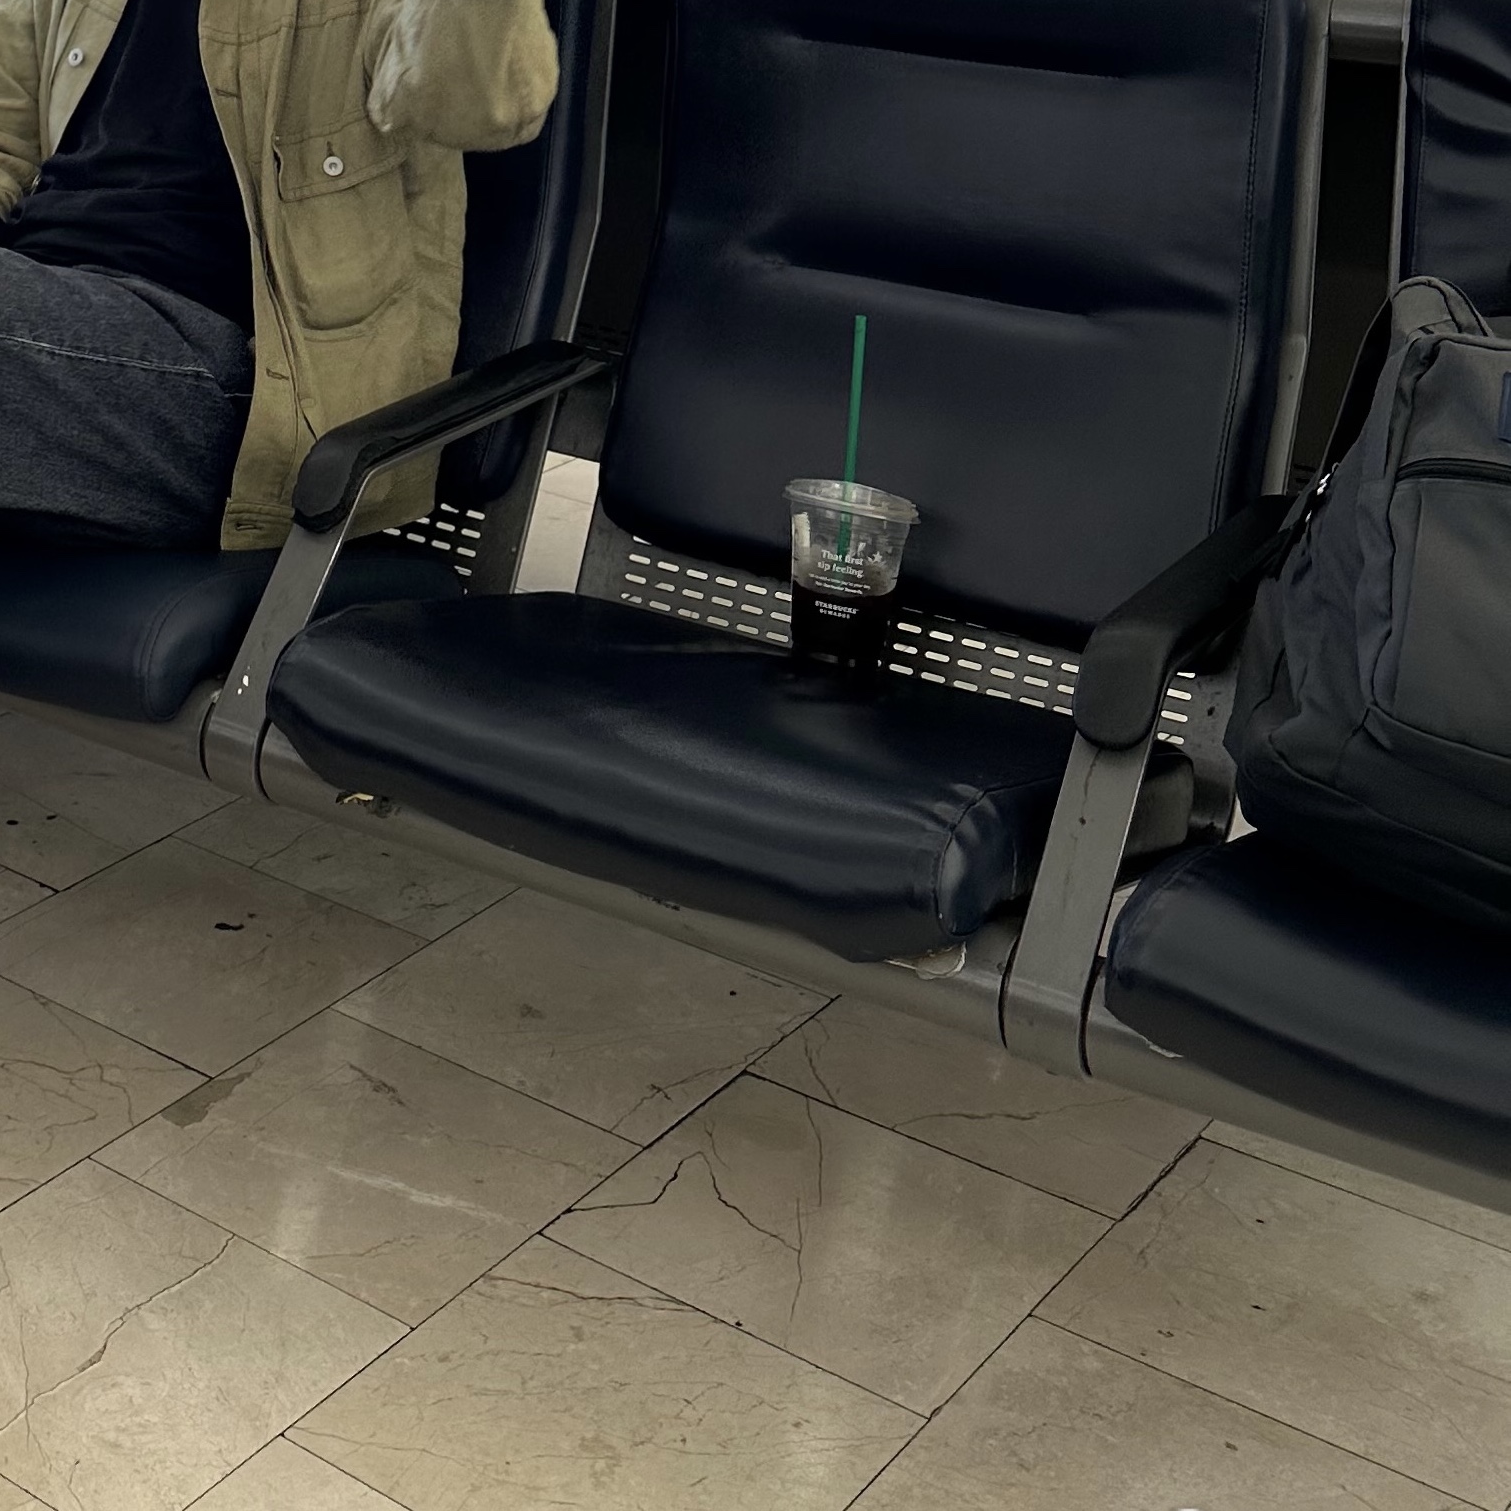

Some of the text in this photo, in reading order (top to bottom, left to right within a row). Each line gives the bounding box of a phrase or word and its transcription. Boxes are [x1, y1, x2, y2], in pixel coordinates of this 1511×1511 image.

[821, 549, 863, 566] That first
[817, 561, 831, 572] sip
